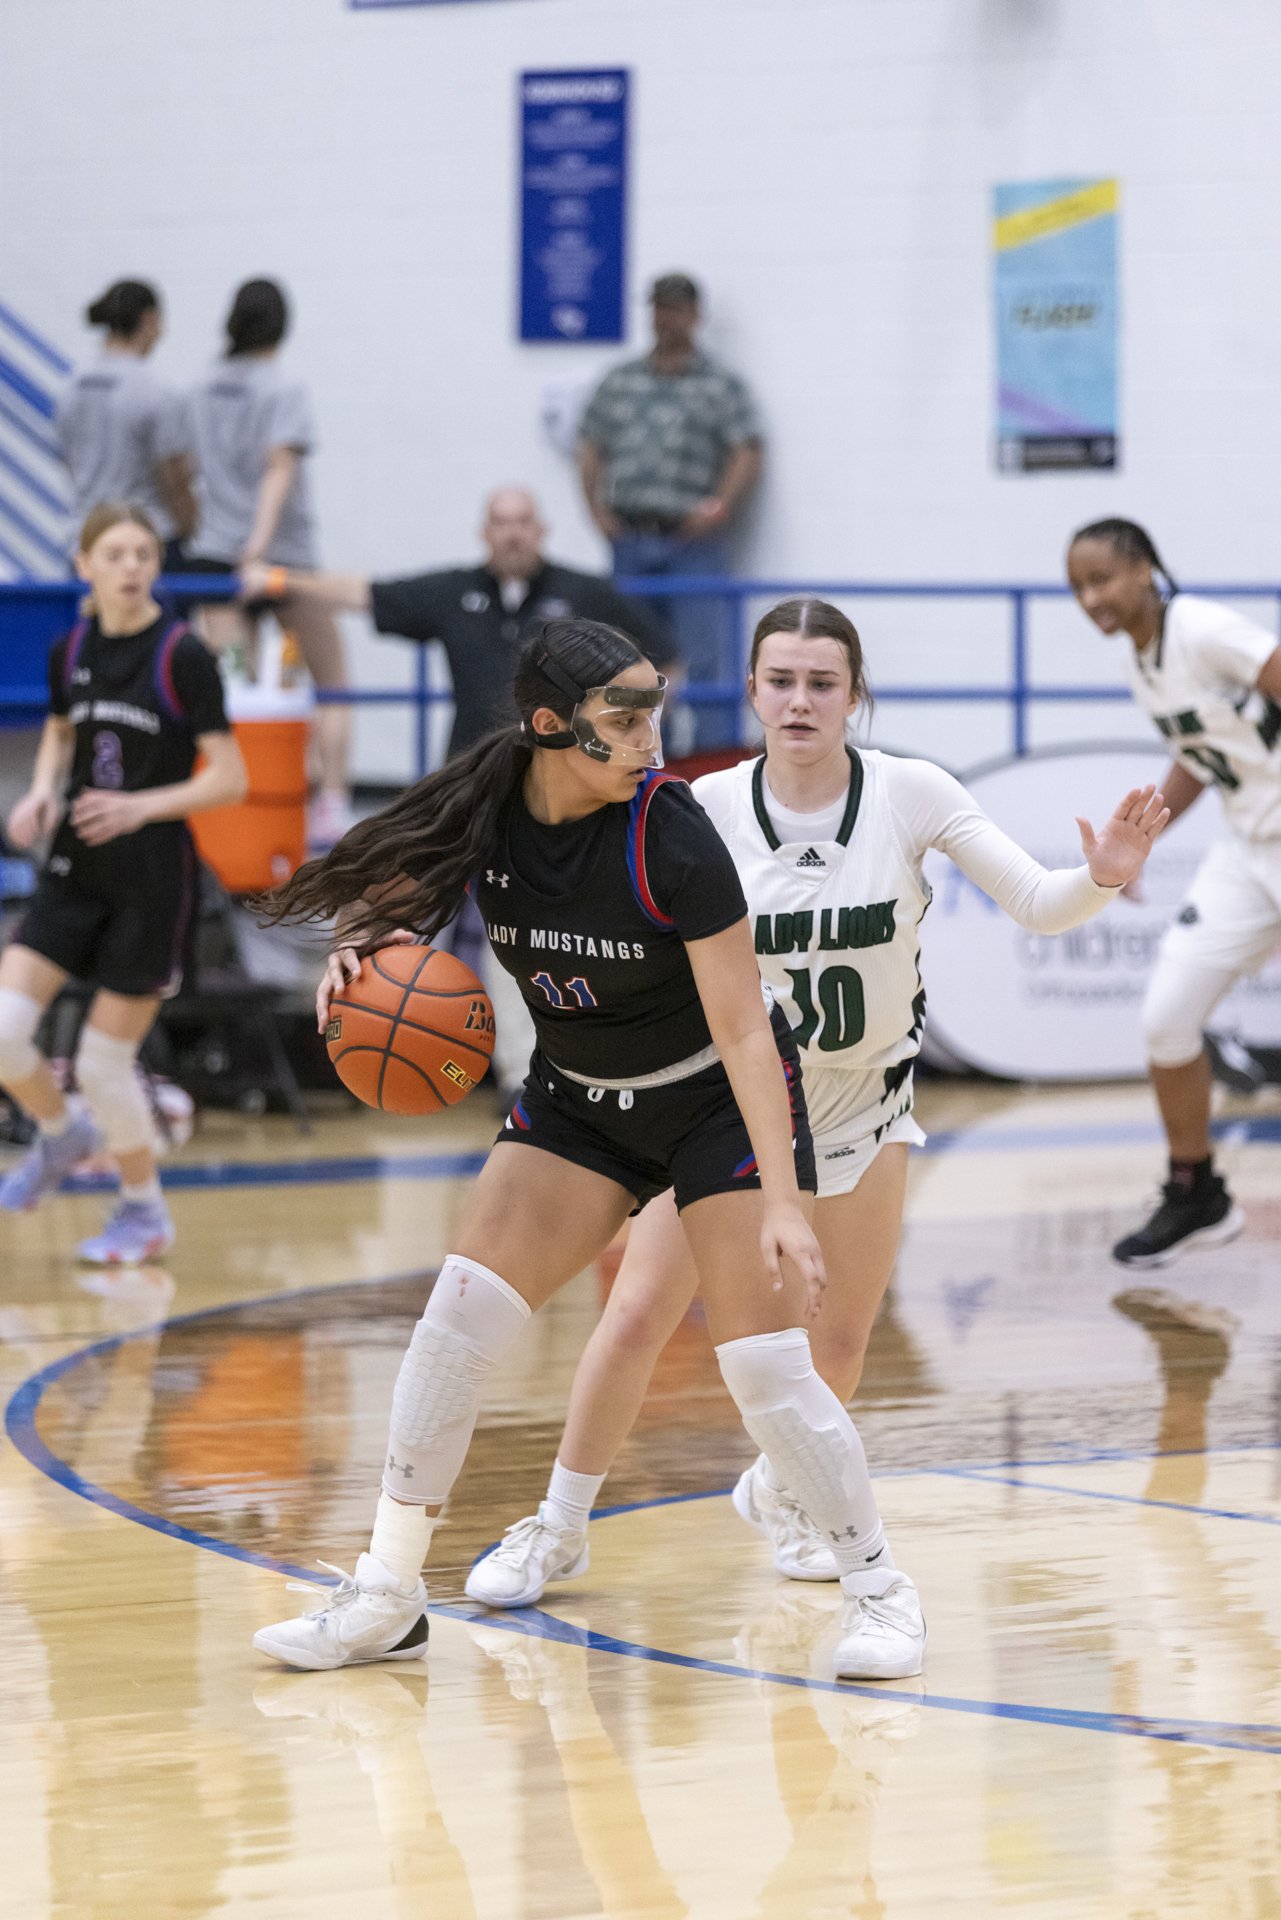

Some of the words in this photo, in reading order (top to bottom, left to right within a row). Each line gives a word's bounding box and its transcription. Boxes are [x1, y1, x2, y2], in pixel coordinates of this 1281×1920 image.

[796, 858, 826, 868] adidas
[488, 922, 518, 946] LADY
[530, 929, 645, 960] MUSTANGS
[755, 909, 815, 955] ADY
[817, 898, 899, 950] LIONS
[530, 971, 599, 1010] 11
[783, 964, 866, 1052] 10
[825, 1148, 855, 1160] adidas
